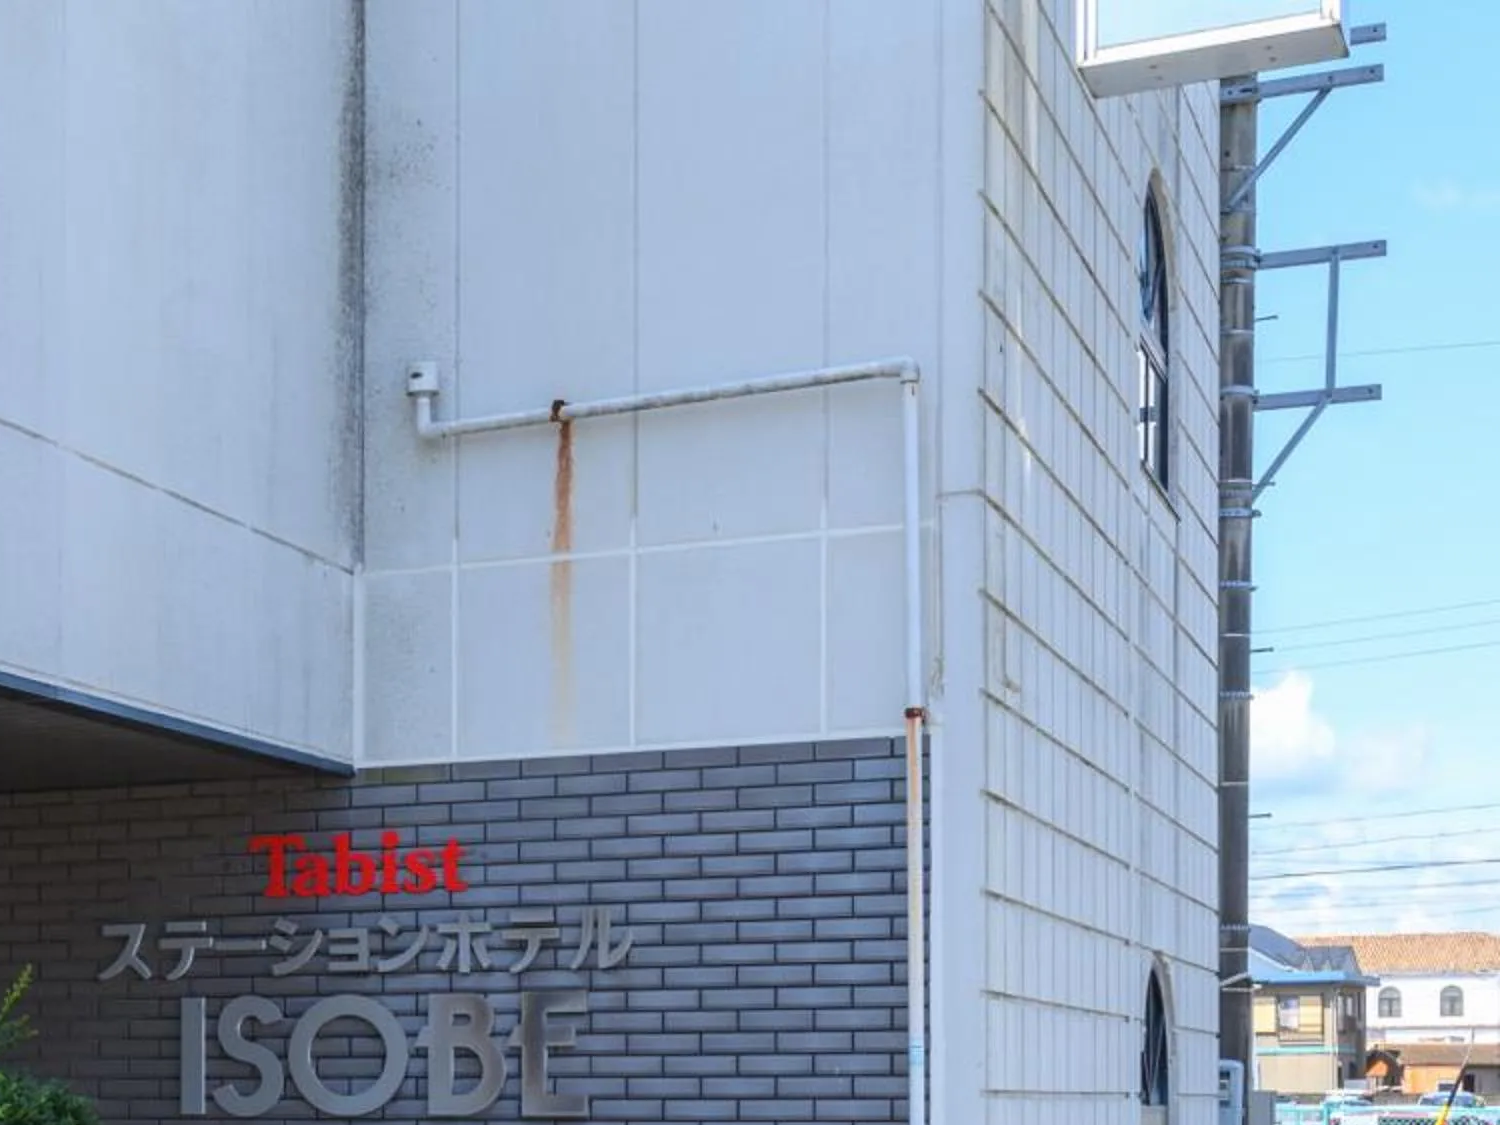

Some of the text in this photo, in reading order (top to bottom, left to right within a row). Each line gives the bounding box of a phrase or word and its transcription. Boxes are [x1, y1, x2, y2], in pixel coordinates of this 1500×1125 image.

[248, 831, 469, 897] Tabist
[98, 907, 636, 981] ステーションホテル
[180, 991, 590, 1119] ISOBE
